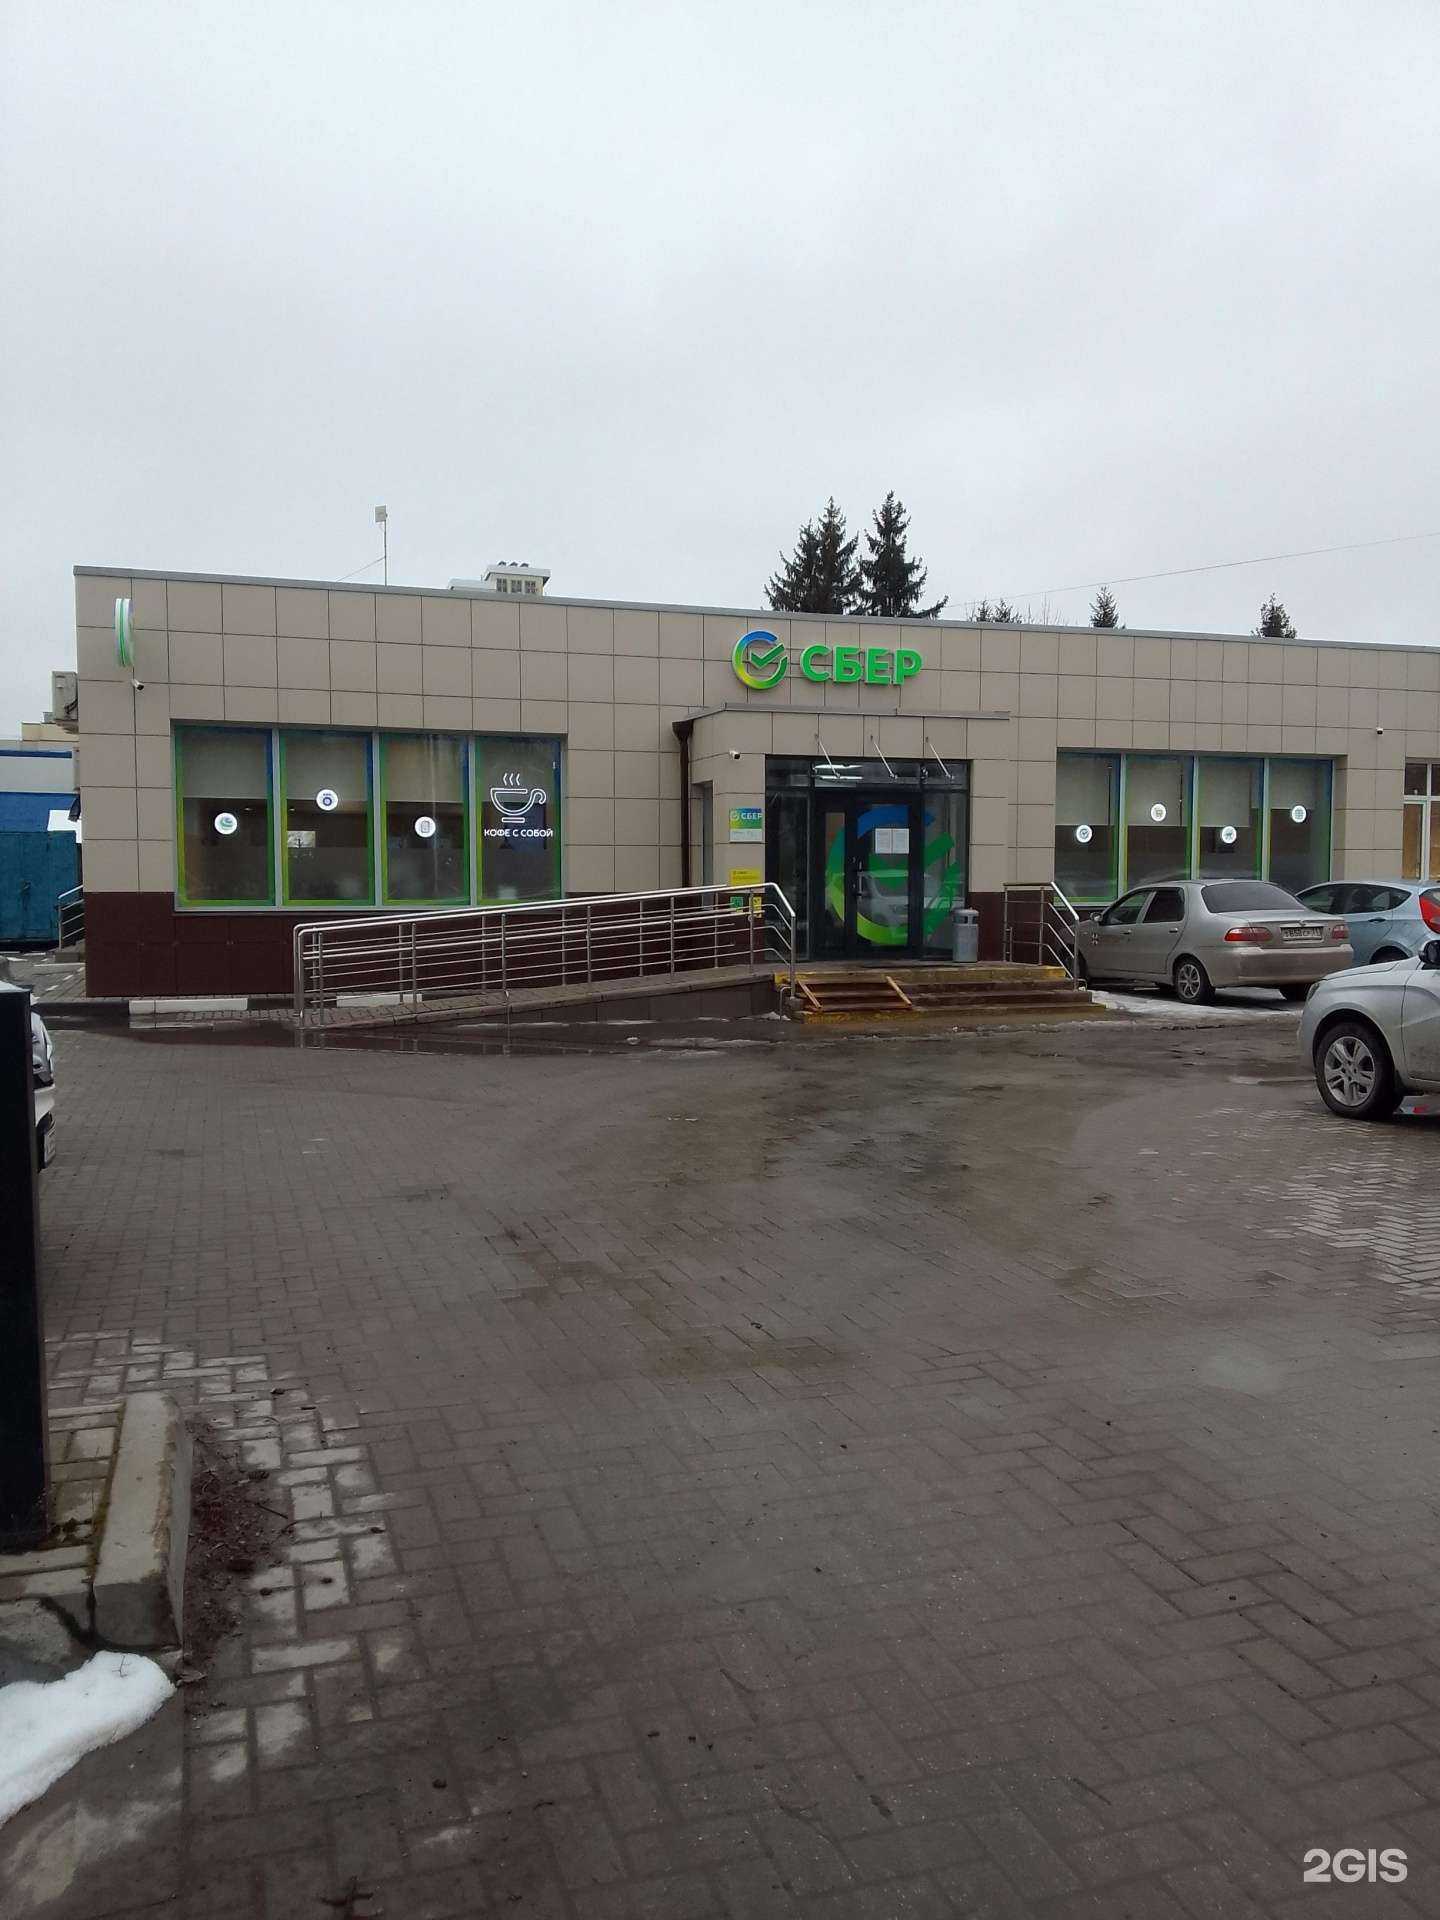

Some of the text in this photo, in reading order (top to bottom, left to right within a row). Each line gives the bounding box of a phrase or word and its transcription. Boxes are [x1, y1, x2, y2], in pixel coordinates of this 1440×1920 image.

[800, 644, 923, 685] СБЕР
[484, 827, 554, 838] КОФЕ С СОБОЙ
